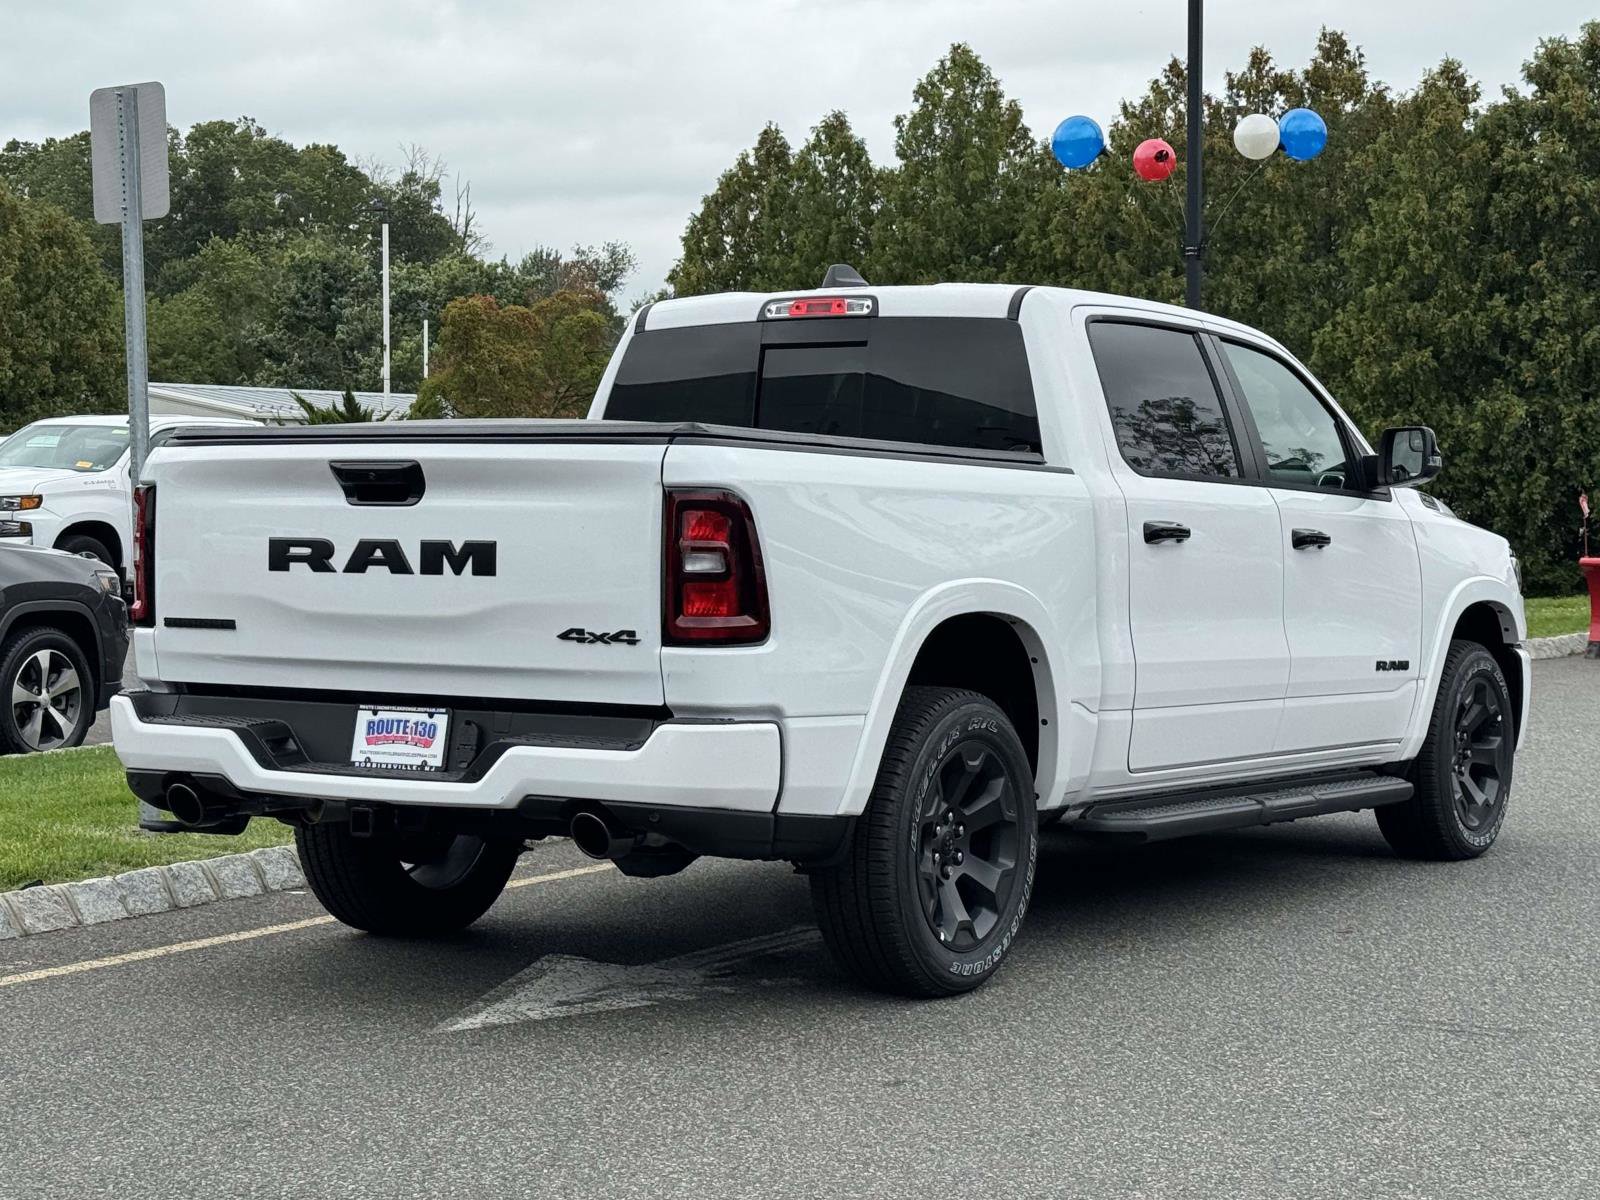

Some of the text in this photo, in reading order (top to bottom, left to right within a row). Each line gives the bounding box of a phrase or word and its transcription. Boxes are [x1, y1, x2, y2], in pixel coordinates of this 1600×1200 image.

[268, 536, 498, 577] RAM
[556, 627, 642, 646] 4x4
[1375, 660, 1410, 672] RAM
[366, 718, 438, 739] ROUTE 130
